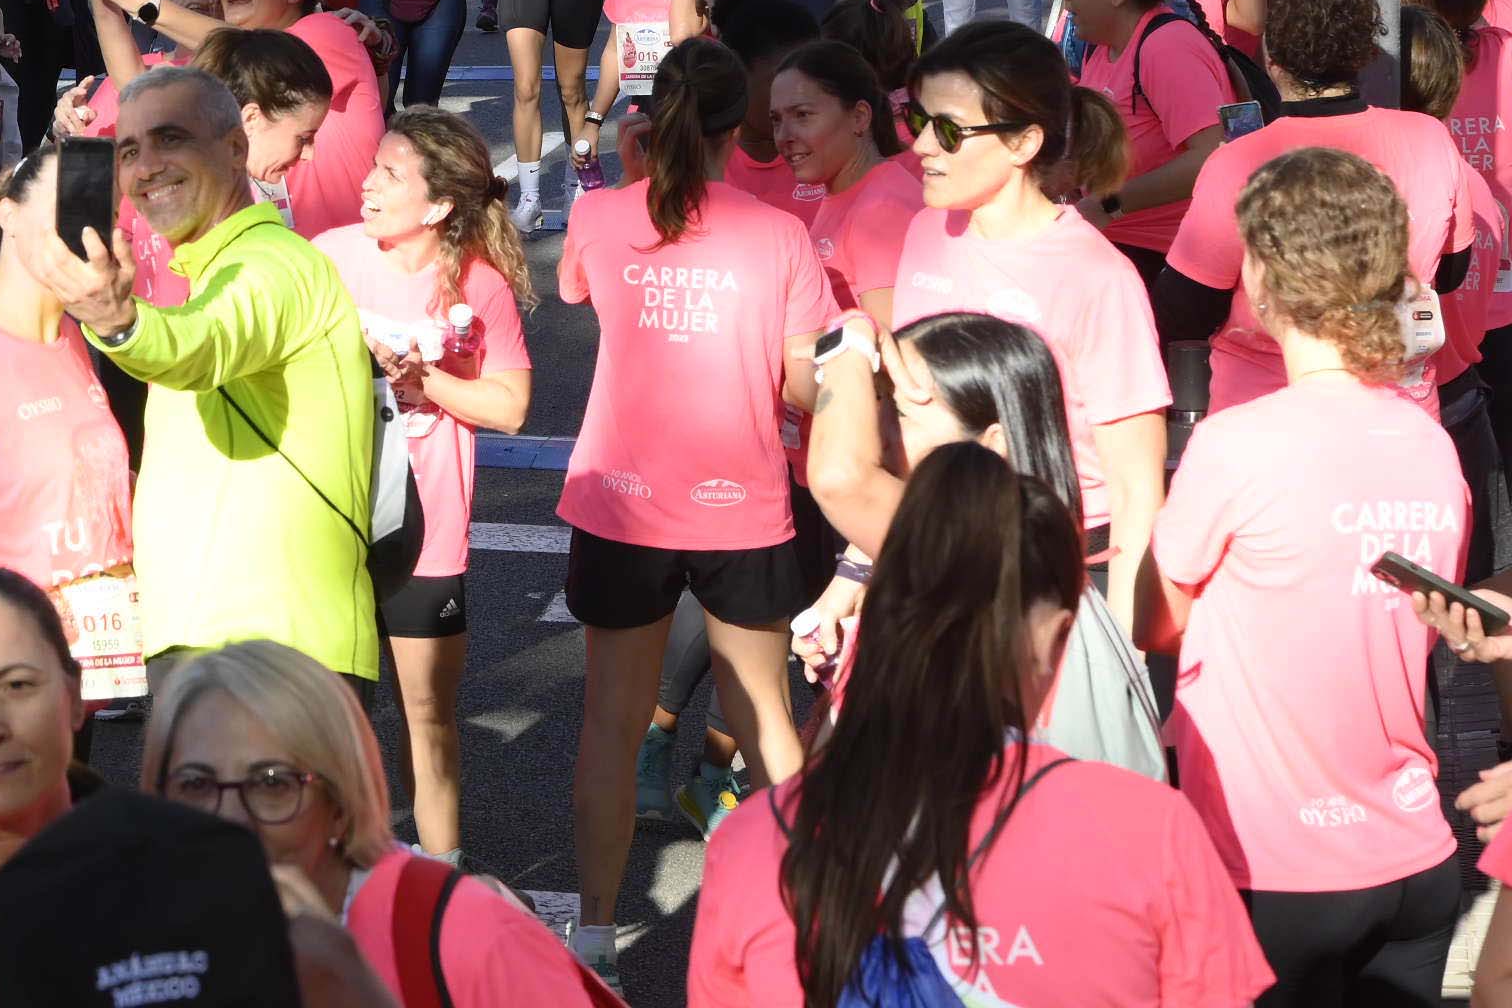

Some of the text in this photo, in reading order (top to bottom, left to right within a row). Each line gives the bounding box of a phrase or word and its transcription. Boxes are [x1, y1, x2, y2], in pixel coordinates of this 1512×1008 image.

[638, 51, 659, 62] 016
[1451, 117, 1506, 136] RERA
[1462, 138, 1489, 154] LA
[622, 264, 737, 291] CARRERA
[643, 288, 715, 311] DE LA
[638, 309, 719, 334] MUJER
[601, 474, 652, 500] OYSHO
[1331, 500, 1459, 534] CARRERA
[42, 517, 86, 556] TU
[1401, 535, 1433, 563] LA
[83, 612, 122, 633] 016
[1299, 804, 1368, 828] OYSHO
